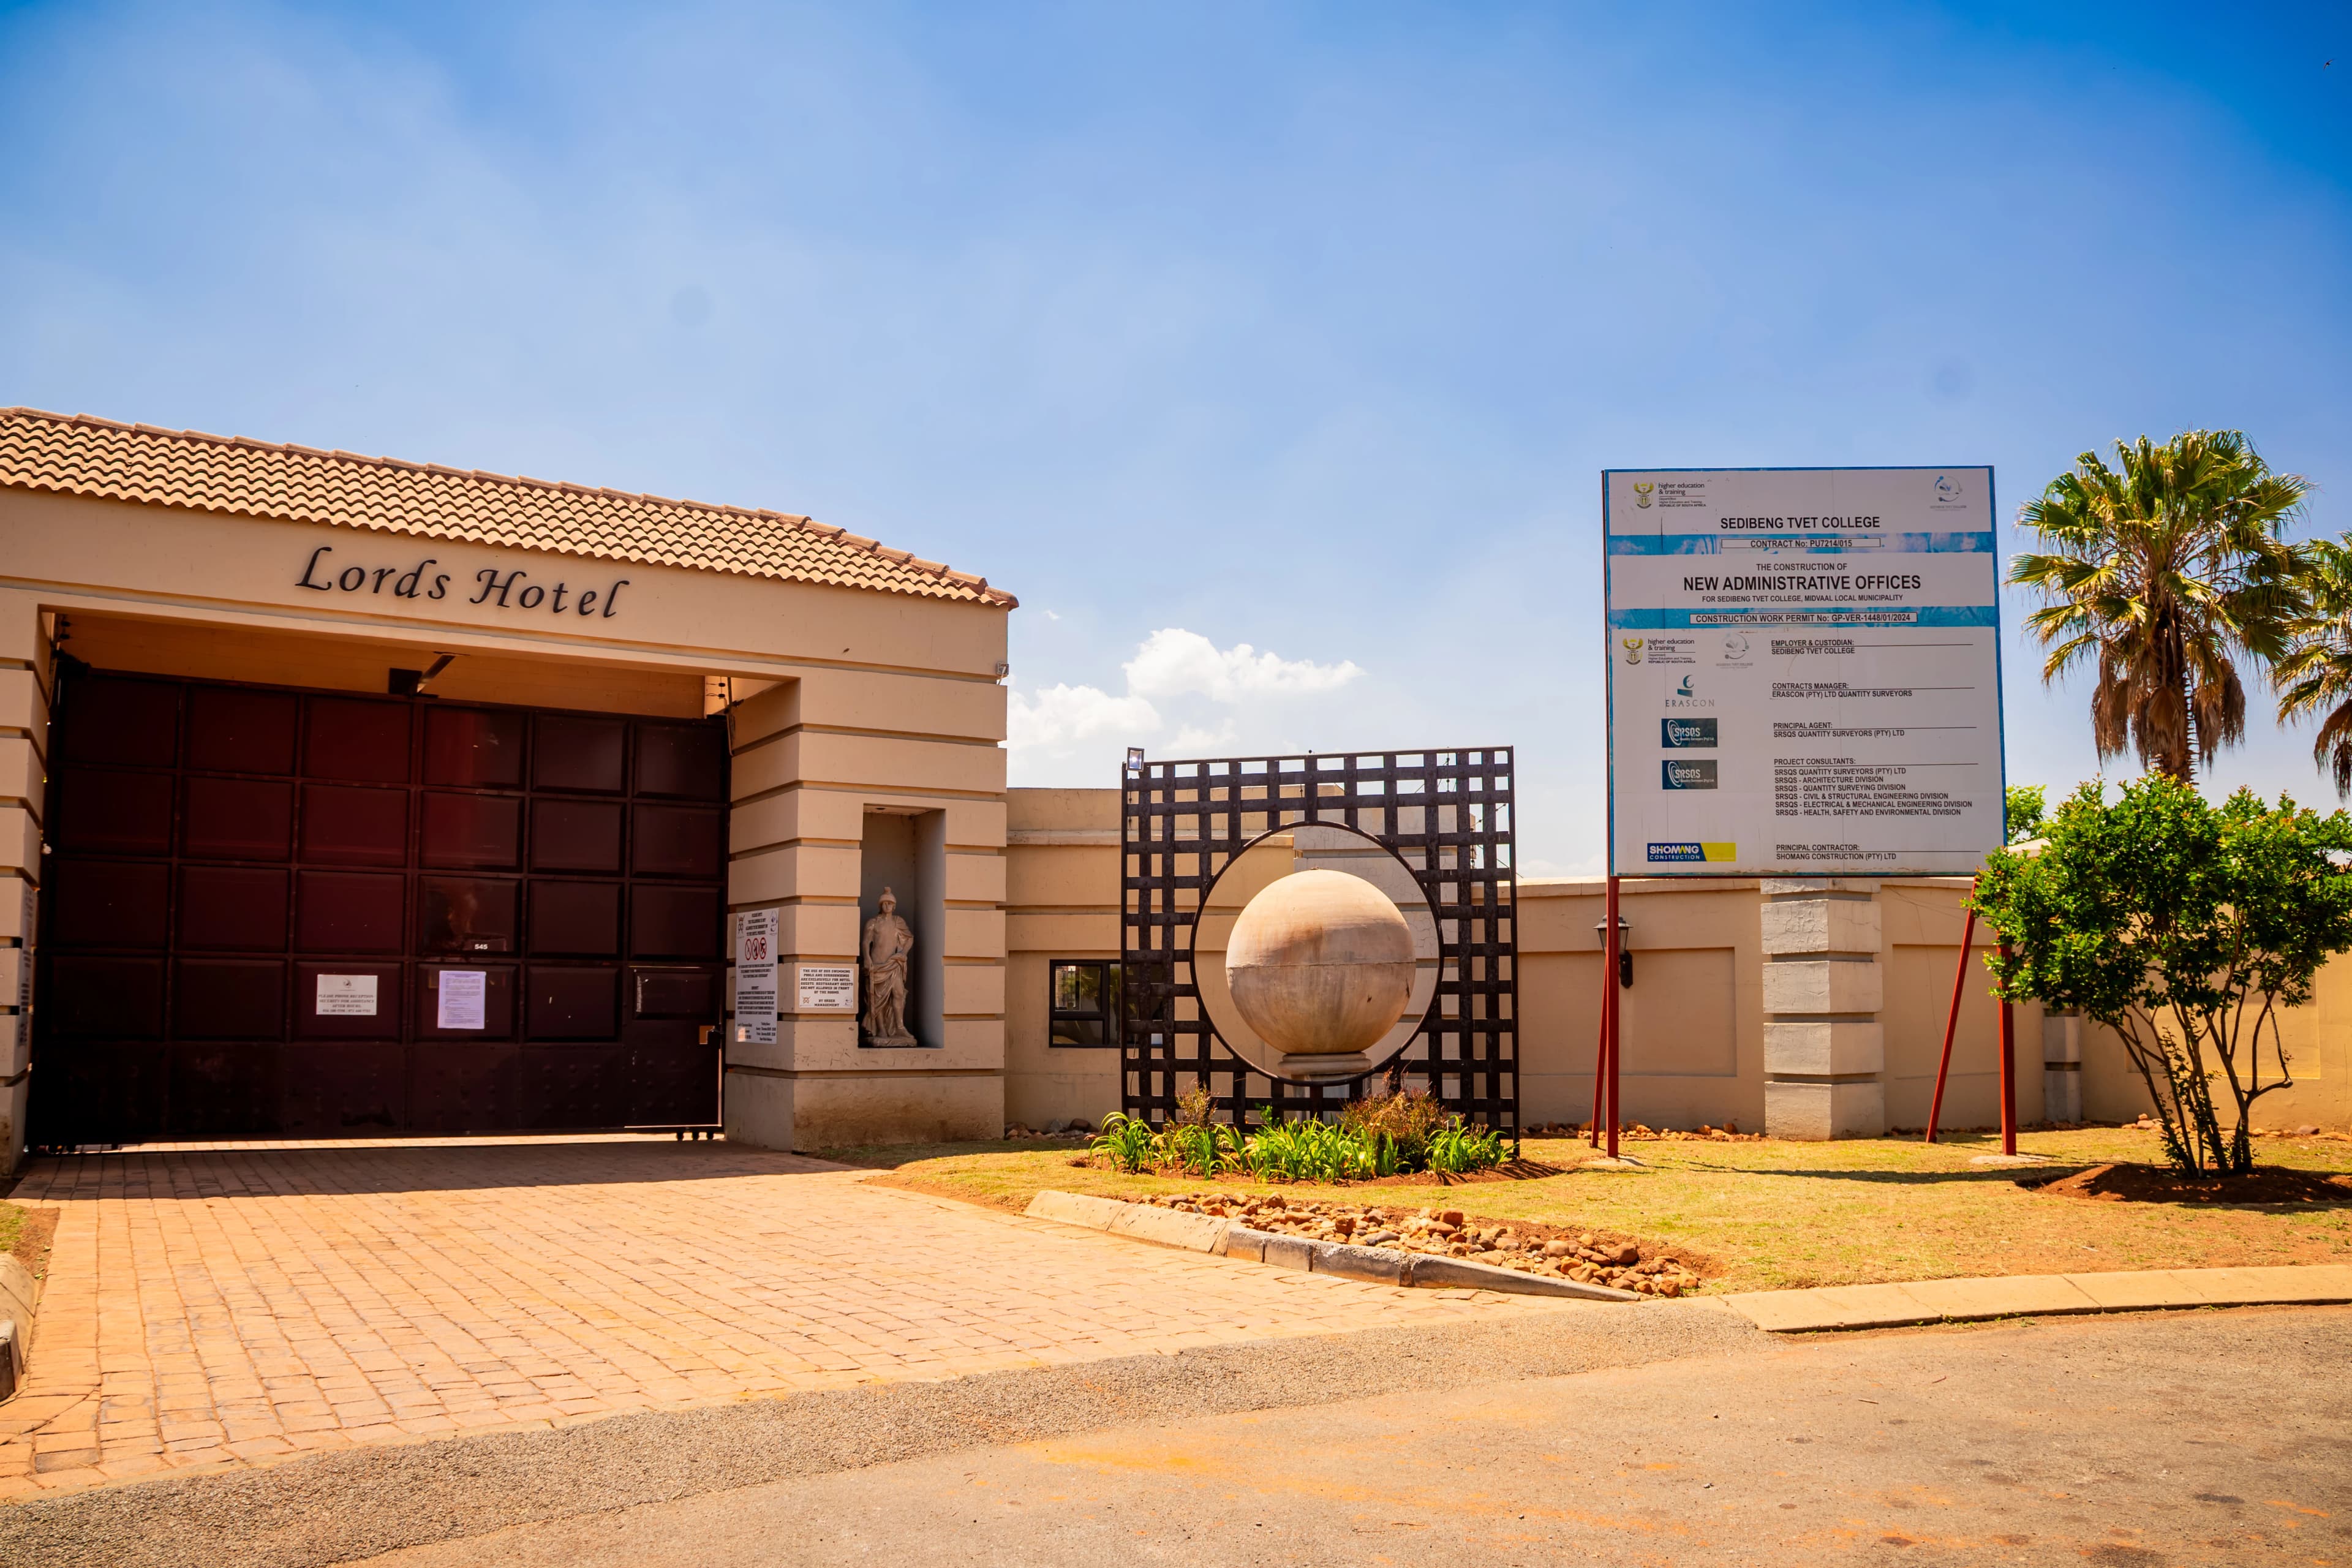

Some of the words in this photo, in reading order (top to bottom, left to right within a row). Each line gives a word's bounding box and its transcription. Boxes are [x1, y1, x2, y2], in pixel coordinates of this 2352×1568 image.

[1721, 517, 1783, 529] SEDIBENG
[1786, 516, 1818, 528] TVET
[1822, 516, 1880, 528] COLLEGE
[1809, 539, 1852, 548] PU7214/015
[1773, 562, 1834, 571] CONSTRUCTION
[295, 546, 450, 600] Lords
[469, 569, 630, 618] Hotel
[1684, 576, 1718, 590] NEW
[1722, 575, 1850, 590] ADMINISTRATIVE
[1855, 575, 1921, 589] OFFICES
[1695, 614, 1757, 623] CONSTRUCTION
[1759, 614, 1784, 623] WORK
[1785, 614, 1815, 622] PERMIT
[1817, 614, 1829, 622] No:
[1831, 614, 1910, 622] GP-VER-1448/01/2024
[1675, 728, 1700, 737] SRSQS
[1675, 769, 1700, 778] SRSQS
[1649, 845, 1699, 854] SHOMANG
